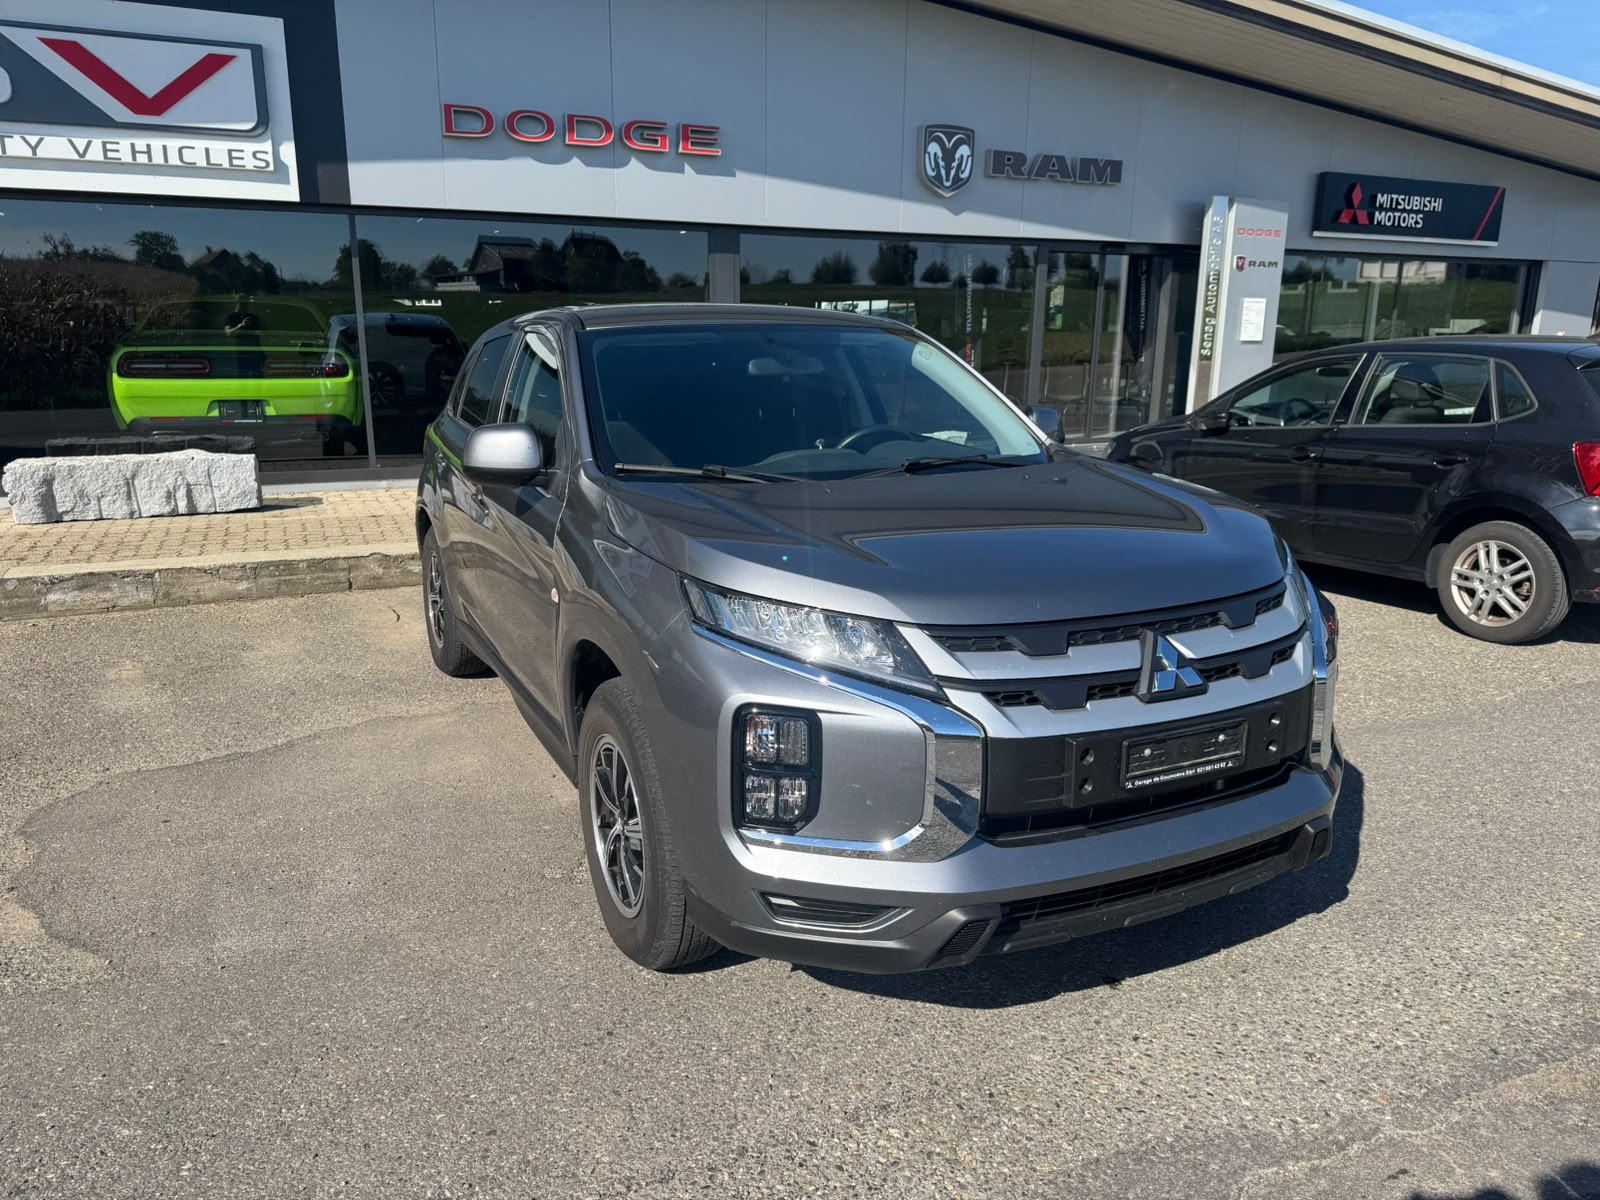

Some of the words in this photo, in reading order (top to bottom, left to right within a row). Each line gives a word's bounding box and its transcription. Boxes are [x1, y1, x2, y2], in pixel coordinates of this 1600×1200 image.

[0, 36, 238, 117] V
[441, 102, 722, 156] DODGE
[66, 137, 271, 170] VEHICLES
[984, 148, 1124, 184] RAM
[1375, 192, 1443, 212] MITSUBISHI
[1236, 227, 1282, 238] DODGE
[1373, 210, 1424, 229] MOTORS
[1247, 260, 1279, 269] RAM
[1201, 317, 1216, 356] Senag
